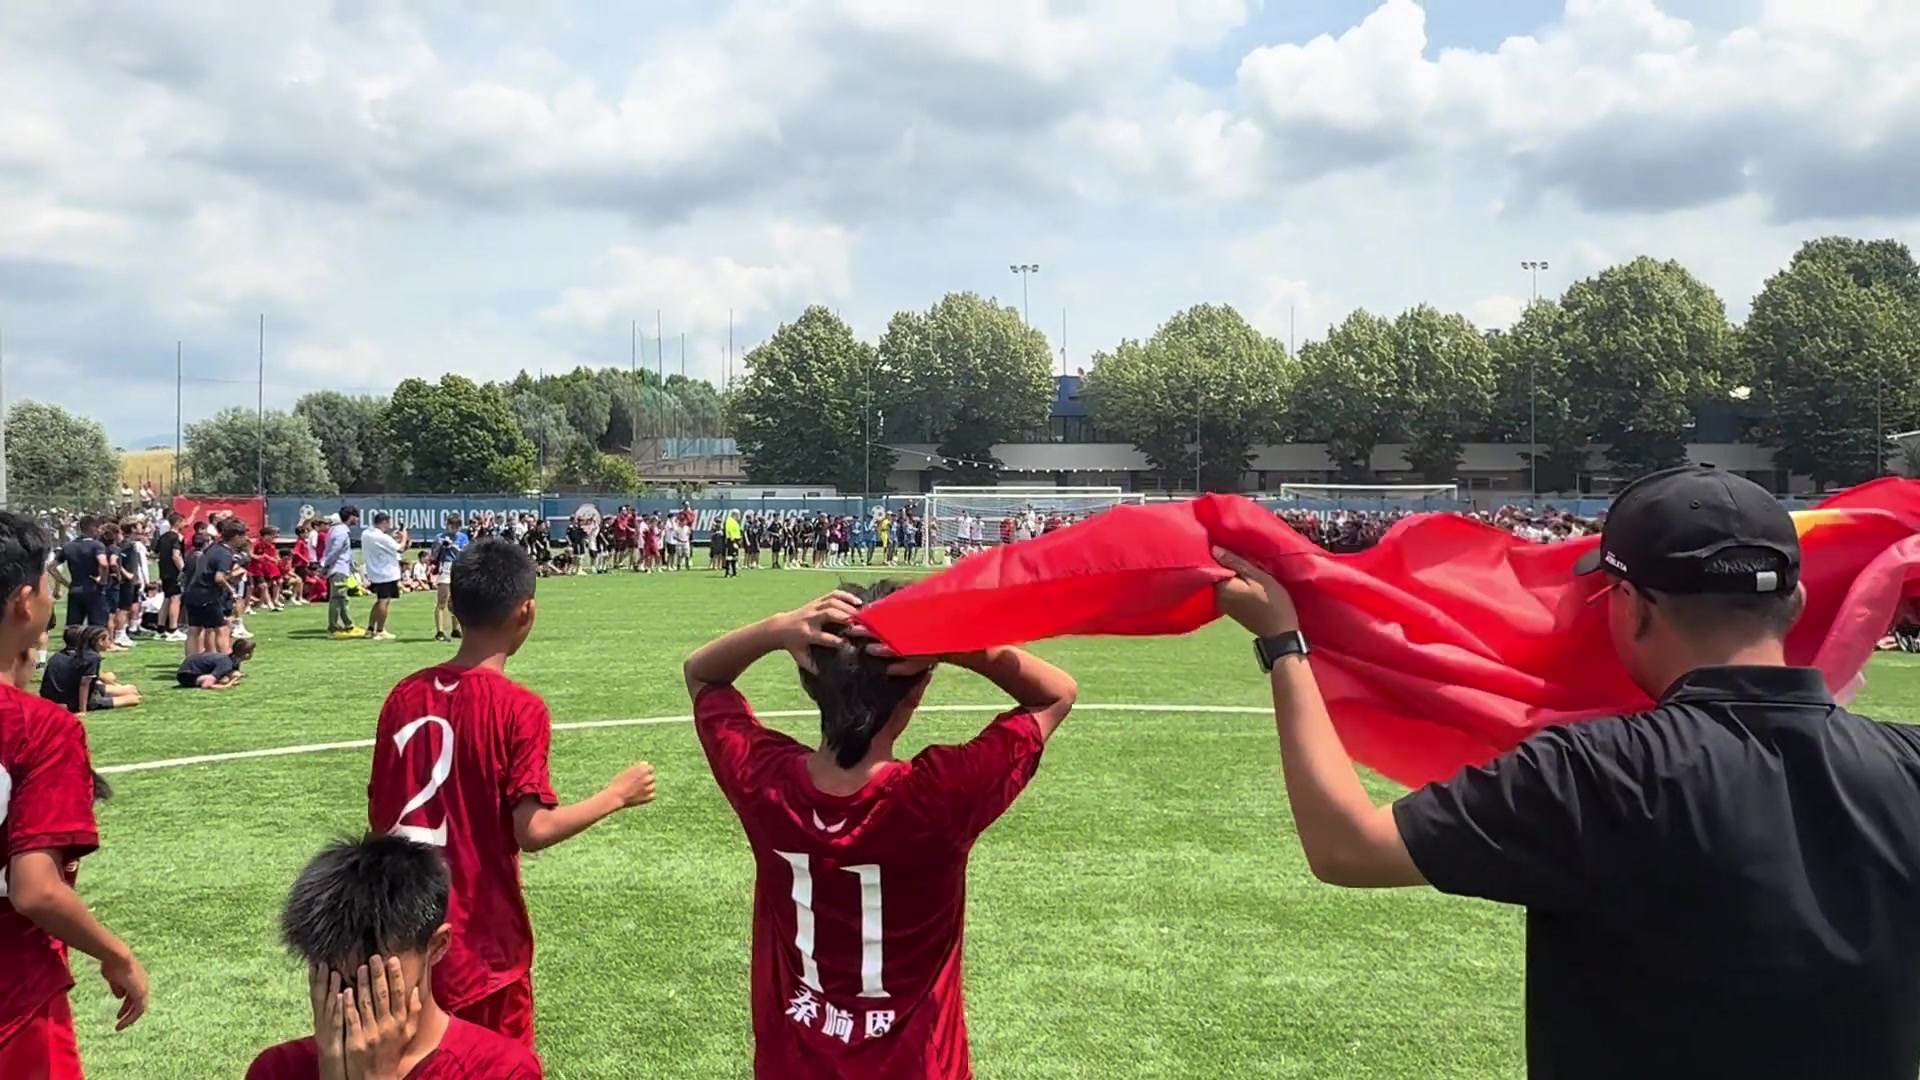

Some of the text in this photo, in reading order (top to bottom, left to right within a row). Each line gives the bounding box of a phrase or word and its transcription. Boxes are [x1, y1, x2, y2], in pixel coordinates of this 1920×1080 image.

[359, 508, 436, 529] LOIGIANI
[387, 714, 454, 847] 2
[772, 848, 892, 998] 11
